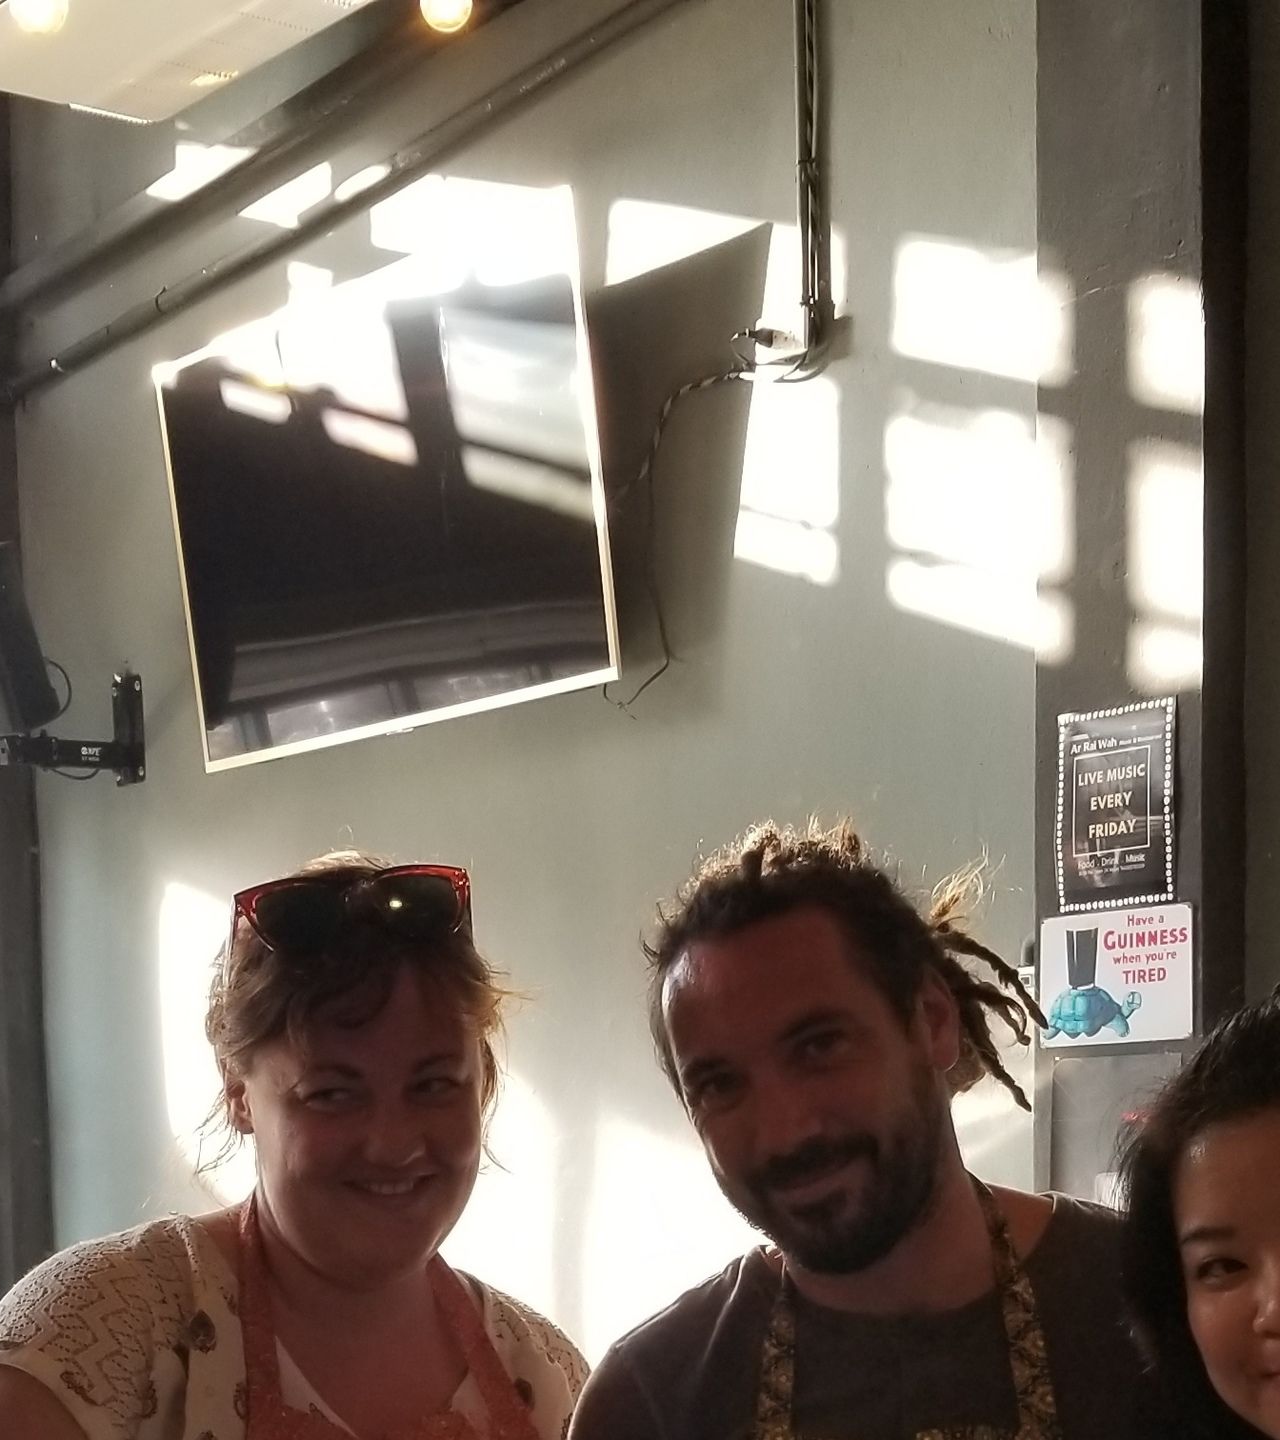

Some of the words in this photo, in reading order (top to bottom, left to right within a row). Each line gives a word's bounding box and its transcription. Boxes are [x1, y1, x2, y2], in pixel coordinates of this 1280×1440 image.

[1097, 737, 1117, 750] Wah
[1078, 770, 1104, 787] LIVE
[1106, 763, 1146, 782] MUSIC
[1090, 791, 1133, 811] EVERY
[1088, 819, 1137, 839] FRIDAY
[1127, 914, 1154, 927] Have
[1159, 915, 1165, 924] a
[1103, 927, 1188, 951] GUINNESS
[1113, 952, 1141, 965] when
[1145, 949, 1177, 965] you're
[1122, 967, 1167, 985] TIRED
